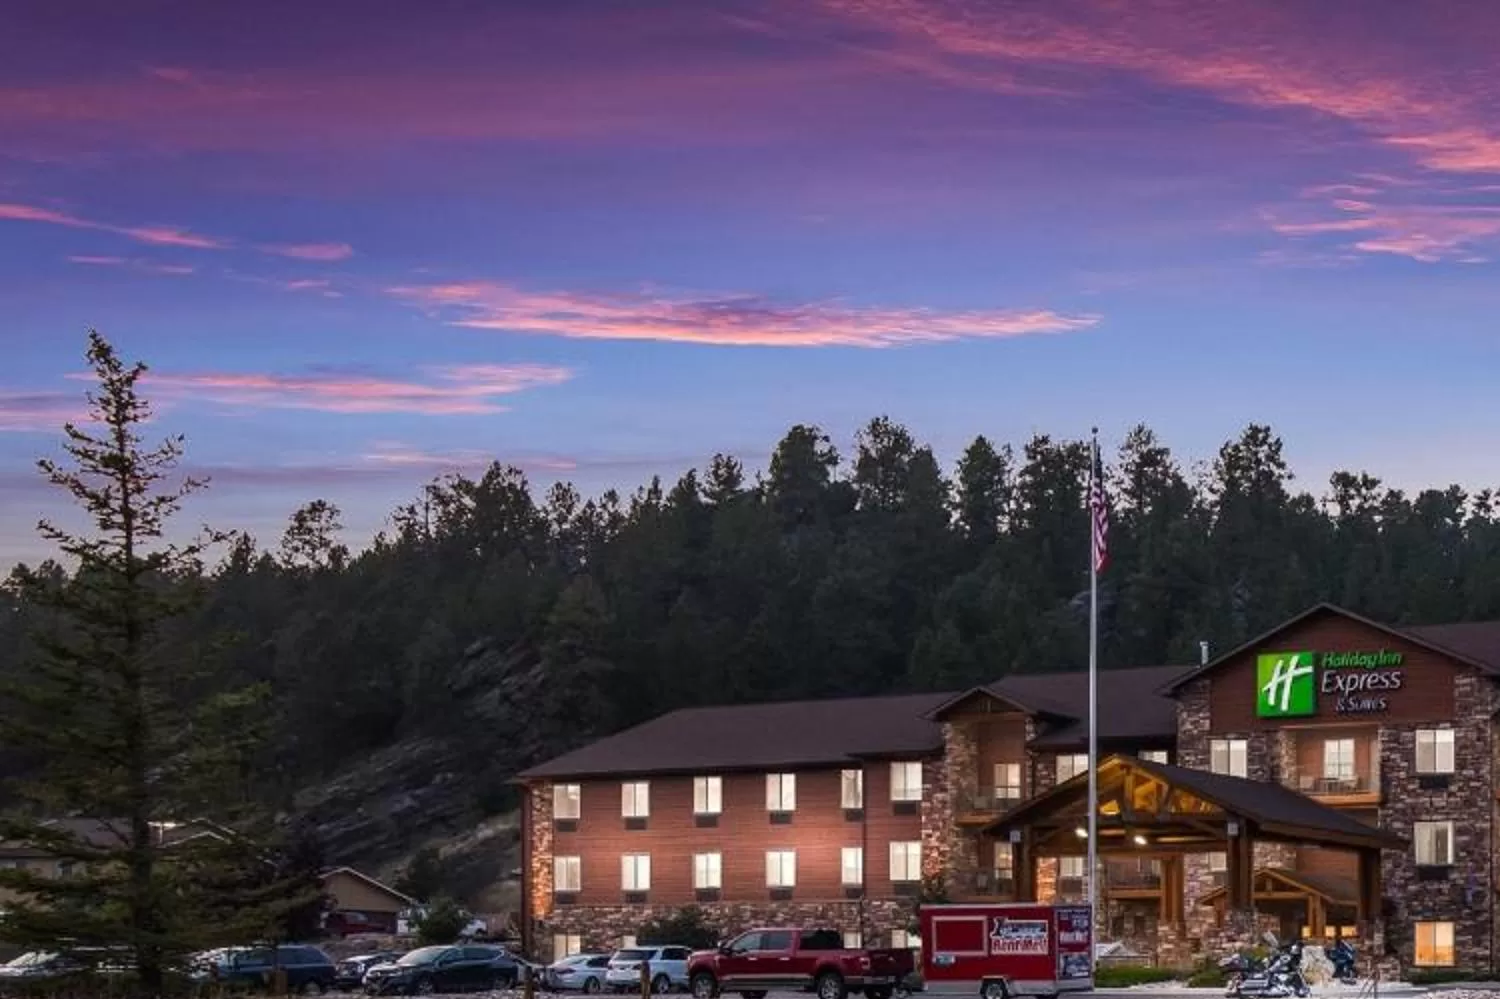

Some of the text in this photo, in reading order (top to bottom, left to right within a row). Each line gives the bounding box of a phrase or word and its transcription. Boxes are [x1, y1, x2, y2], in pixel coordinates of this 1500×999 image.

[1322, 649, 1401, 668] Holiday Inn
[1321, 670, 1401, 696] Express
